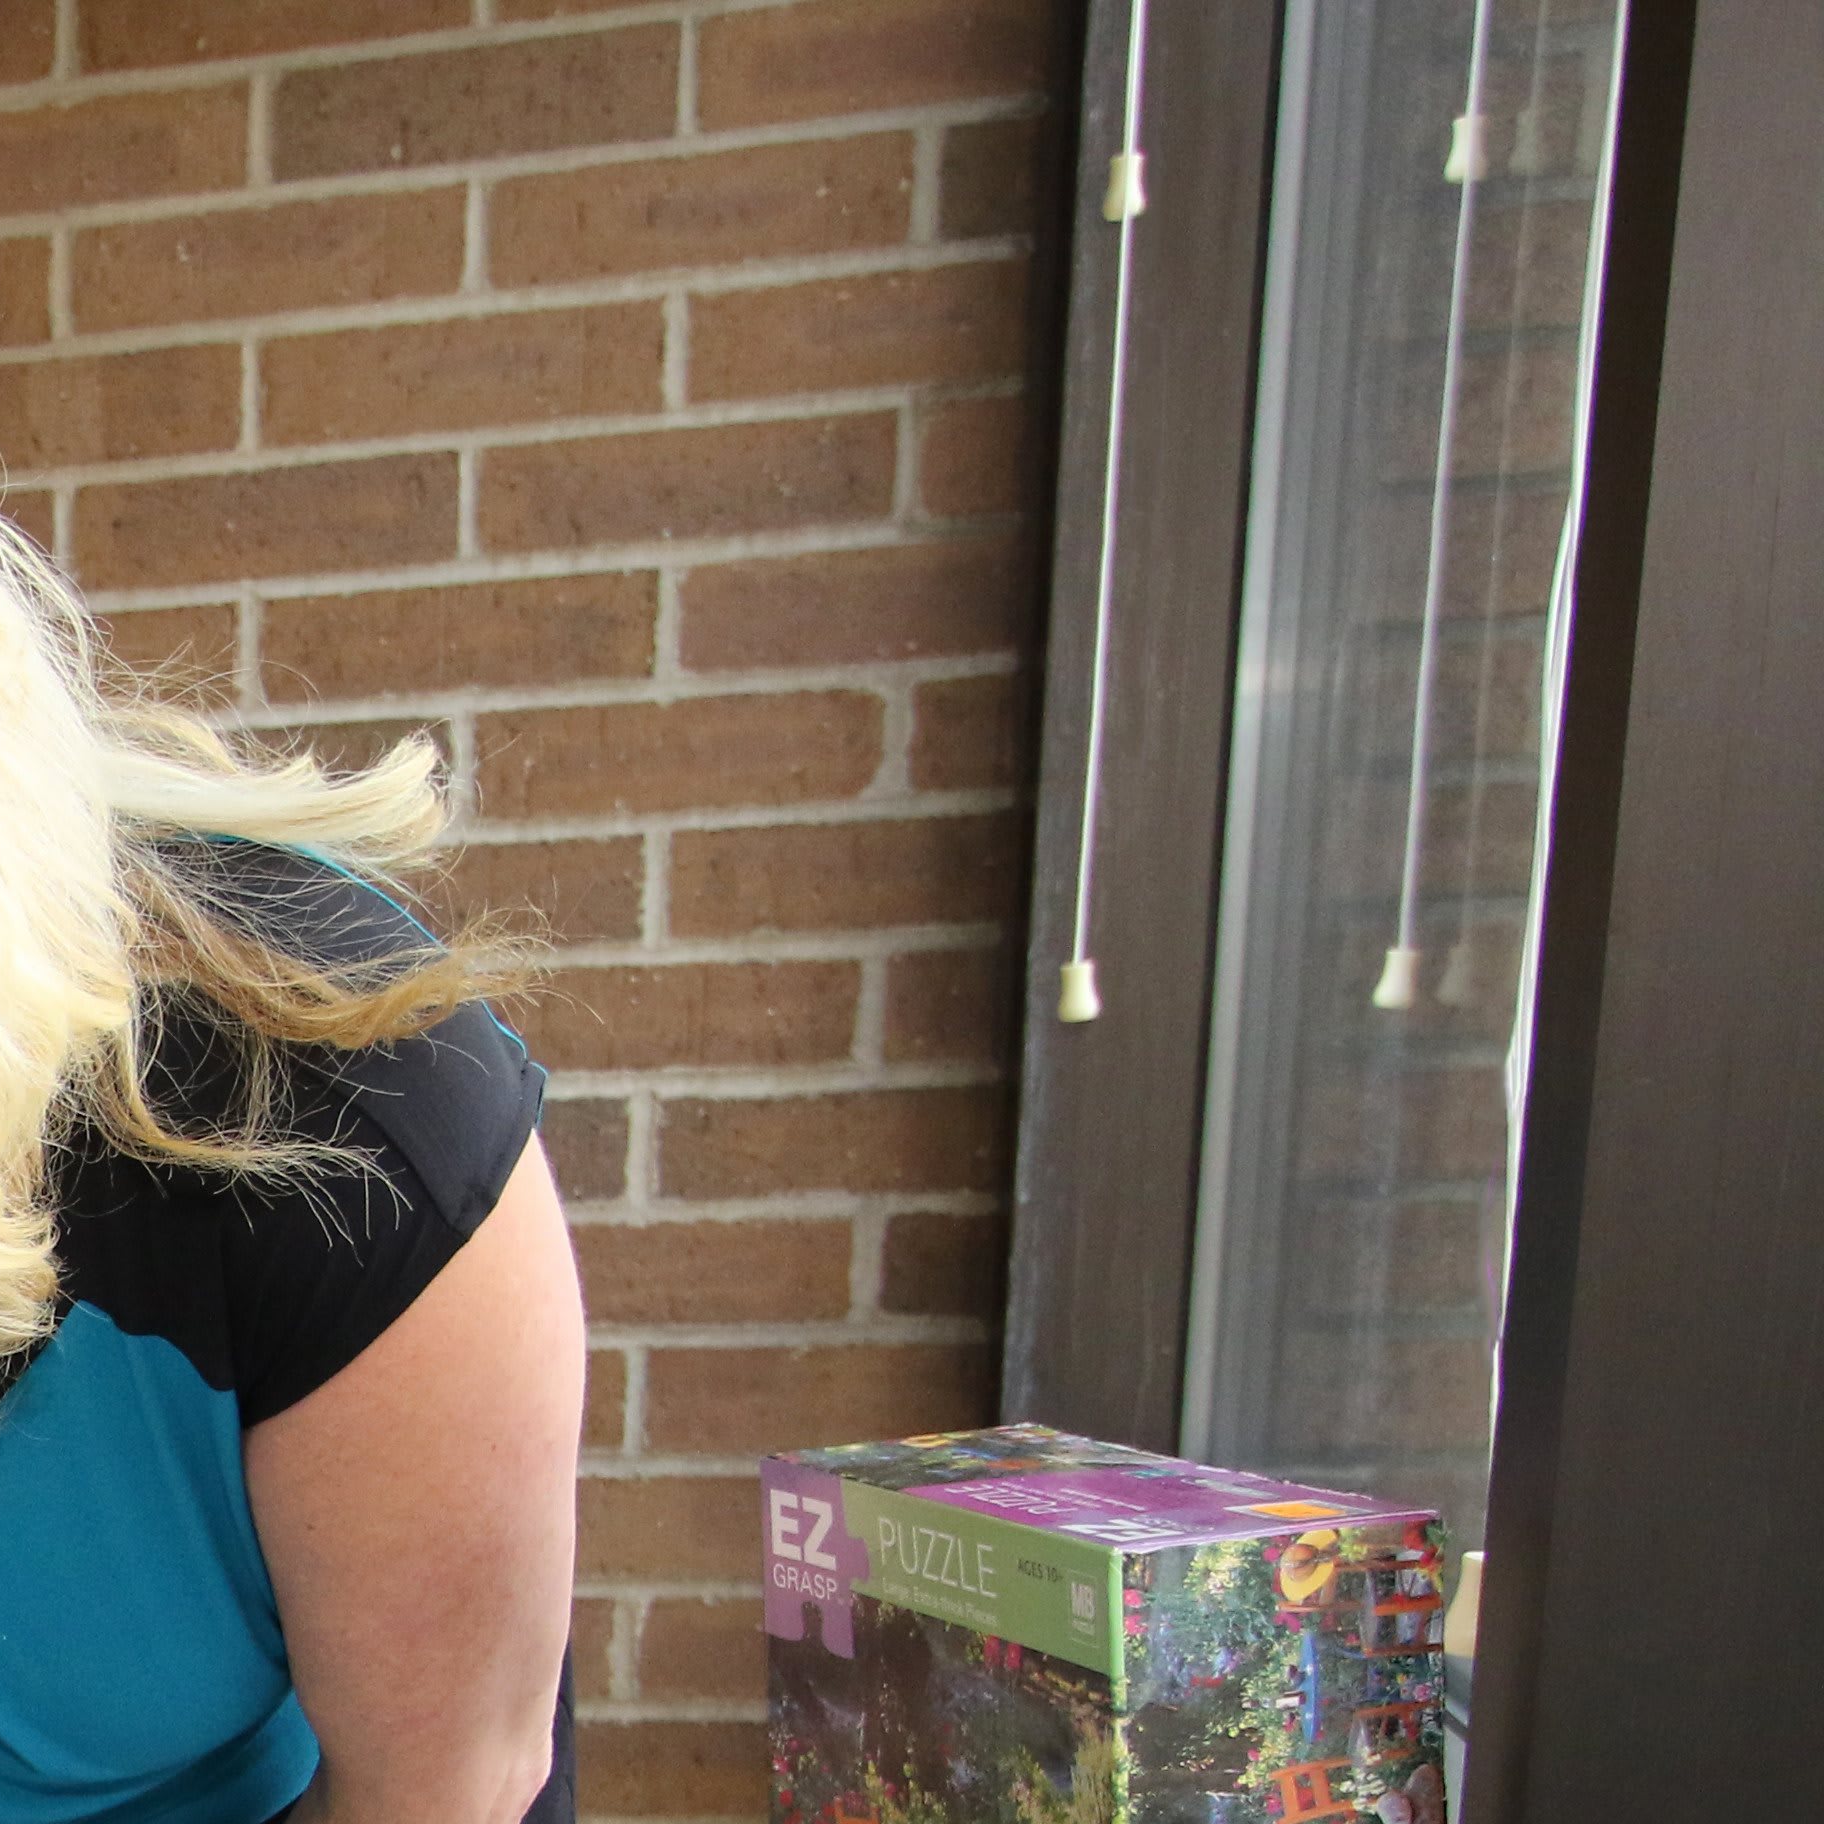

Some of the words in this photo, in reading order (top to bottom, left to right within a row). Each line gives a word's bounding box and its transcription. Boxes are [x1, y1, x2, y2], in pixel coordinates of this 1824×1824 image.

[770, 1488, 837, 1571] EZ
[878, 1516, 998, 1598] PUZZLE
[1017, 1558, 1046, 1580] AGES
[773, 1563, 838, 1601] GRASP
[1070, 1582, 1096, 1618] MB
